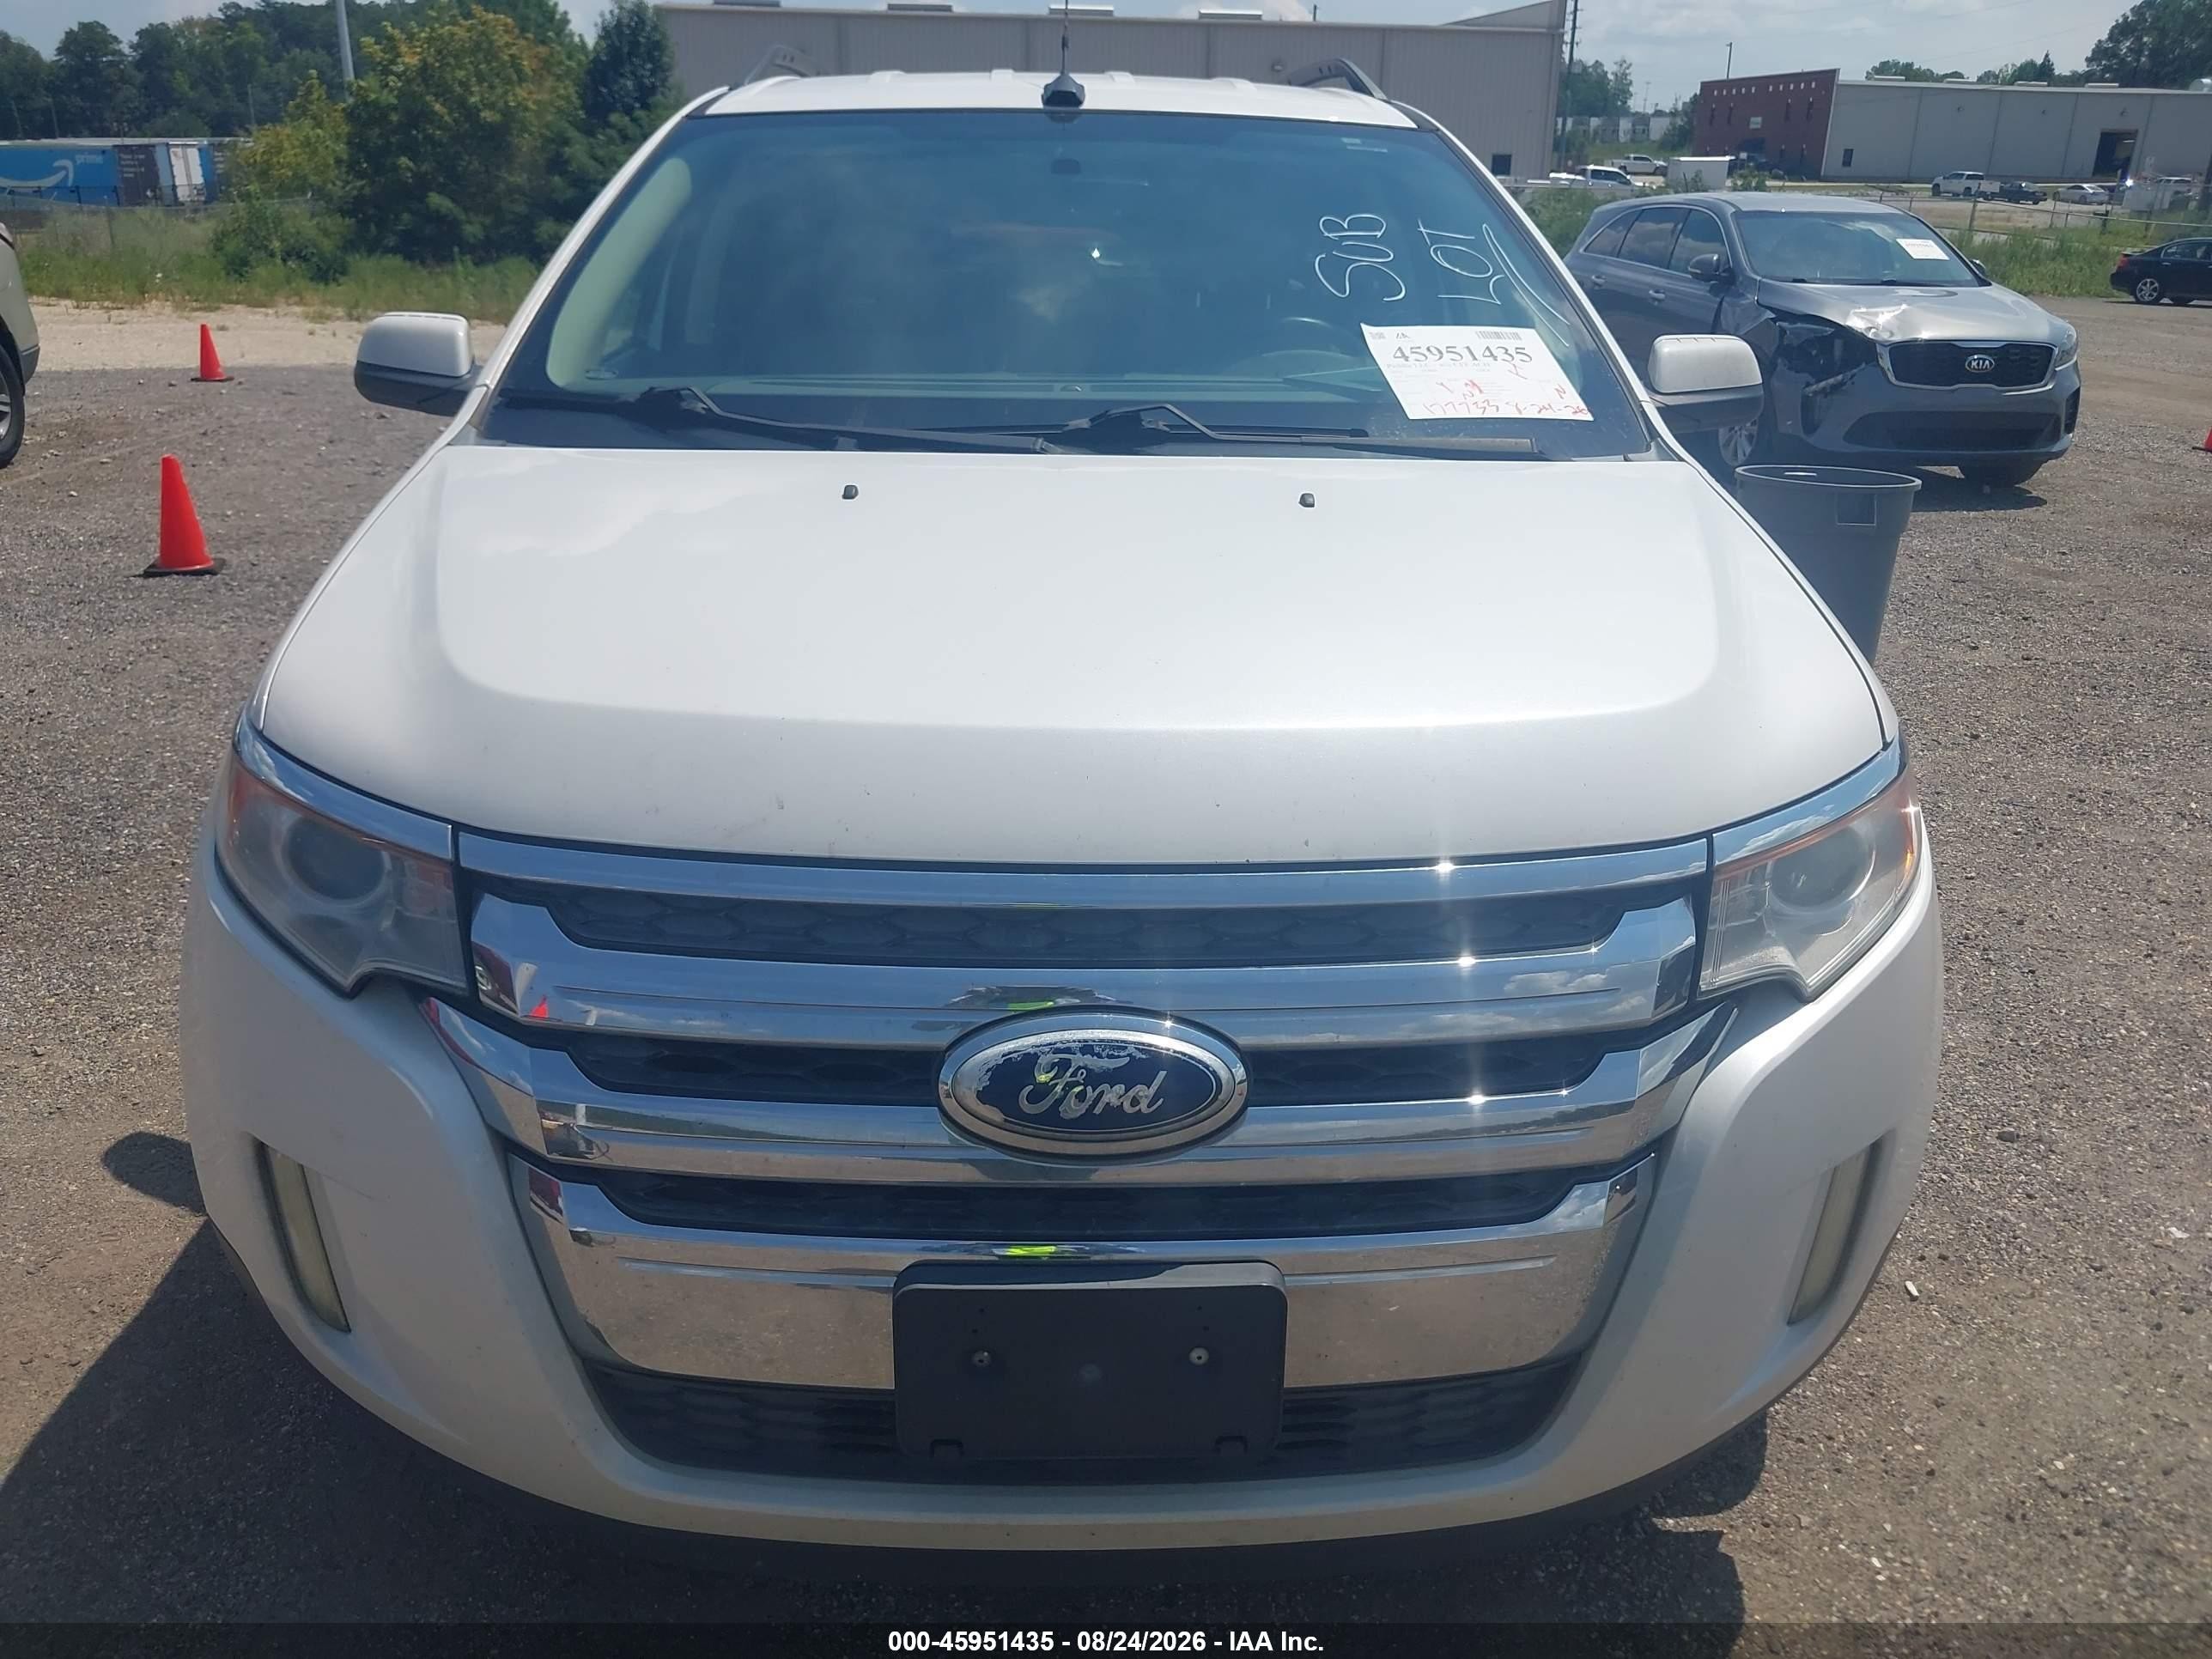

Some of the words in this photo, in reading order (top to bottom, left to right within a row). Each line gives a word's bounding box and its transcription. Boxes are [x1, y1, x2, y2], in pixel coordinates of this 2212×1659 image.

[1315, 214, 1407, 301] SUB
[1418, 219, 1504, 305] LOT
[1393, 345, 1533, 362] 45951435
[1971, 360, 1990, 370] KIA
[1018, 1053, 1168, 1120] Ford
